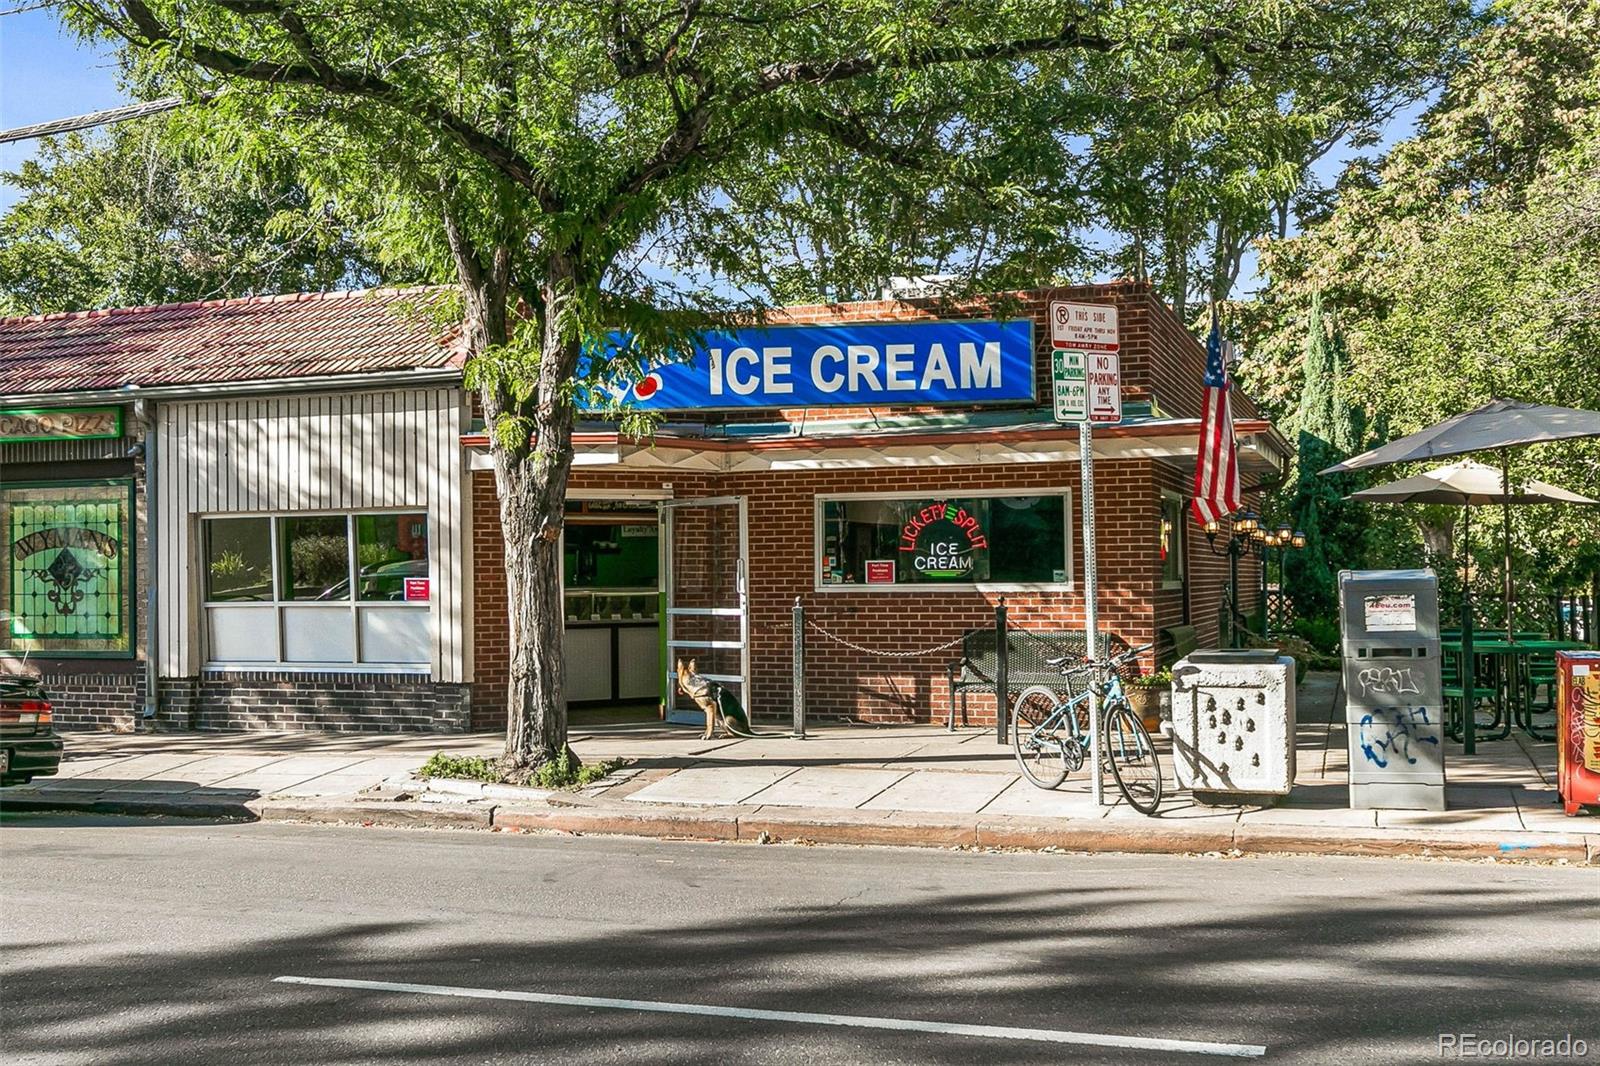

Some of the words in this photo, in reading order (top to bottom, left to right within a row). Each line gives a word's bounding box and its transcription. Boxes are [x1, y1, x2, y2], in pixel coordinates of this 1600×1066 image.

[1075, 310, 1088, 322] THIS
[1093, 312, 1106, 323] SIDE
[1054, 358, 1064, 374] 30
[1069, 355, 1079, 366] MIN
[1096, 356, 1109, 370] NO
[709, 346, 793, 396] ICE
[810, 341, 1002, 394] CREAM
[1064, 367, 1085, 378] PARKING
[1089, 373, 1117, 386] PARKING
[1057, 385, 1084, 397] 8AM-6PM
[1098, 386, 1110, 396] ANY
[1097, 396, 1111, 406] TIME
[899, 503, 947, 552] LICKETY
[952, 508, 987, 549] SPLIT
[930, 542, 959, 556] ICE
[914, 556, 972, 570] CREAM
